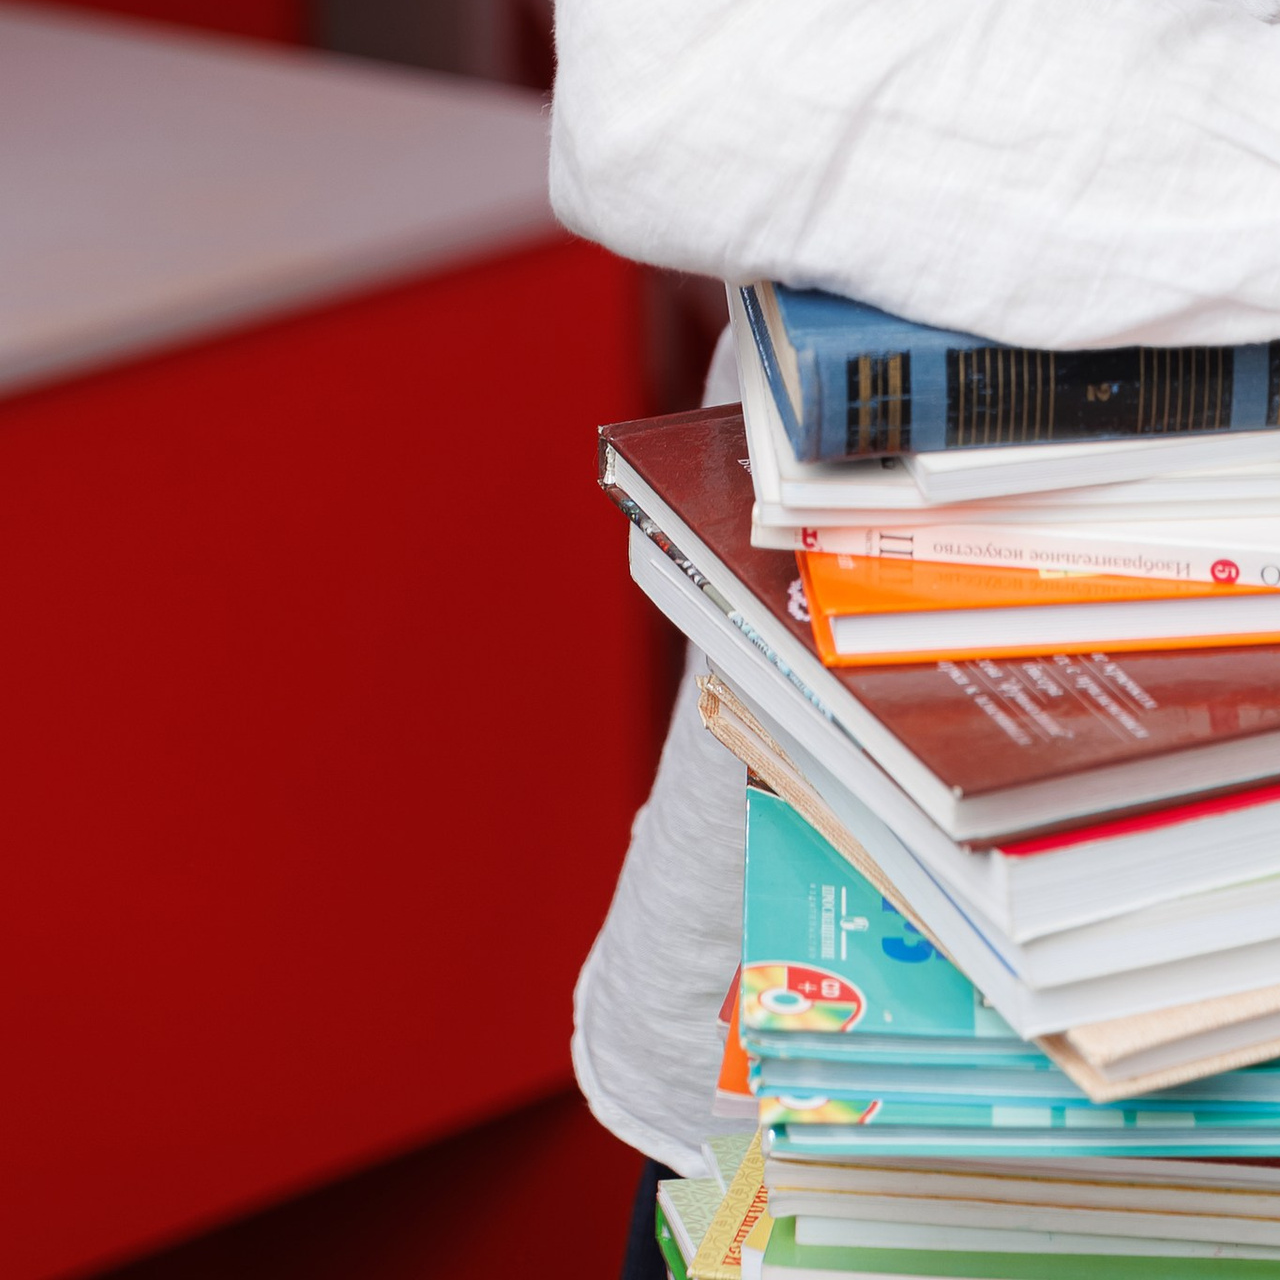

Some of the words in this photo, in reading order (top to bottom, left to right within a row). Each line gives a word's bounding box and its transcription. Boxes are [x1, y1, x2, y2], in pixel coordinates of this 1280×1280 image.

[1087, 382, 1110, 402] 2
[933, 542, 1024, 561] искусство
[1029, 550, 1191, 577] Изобразительное
[1214, 564, 1236, 579] 5
